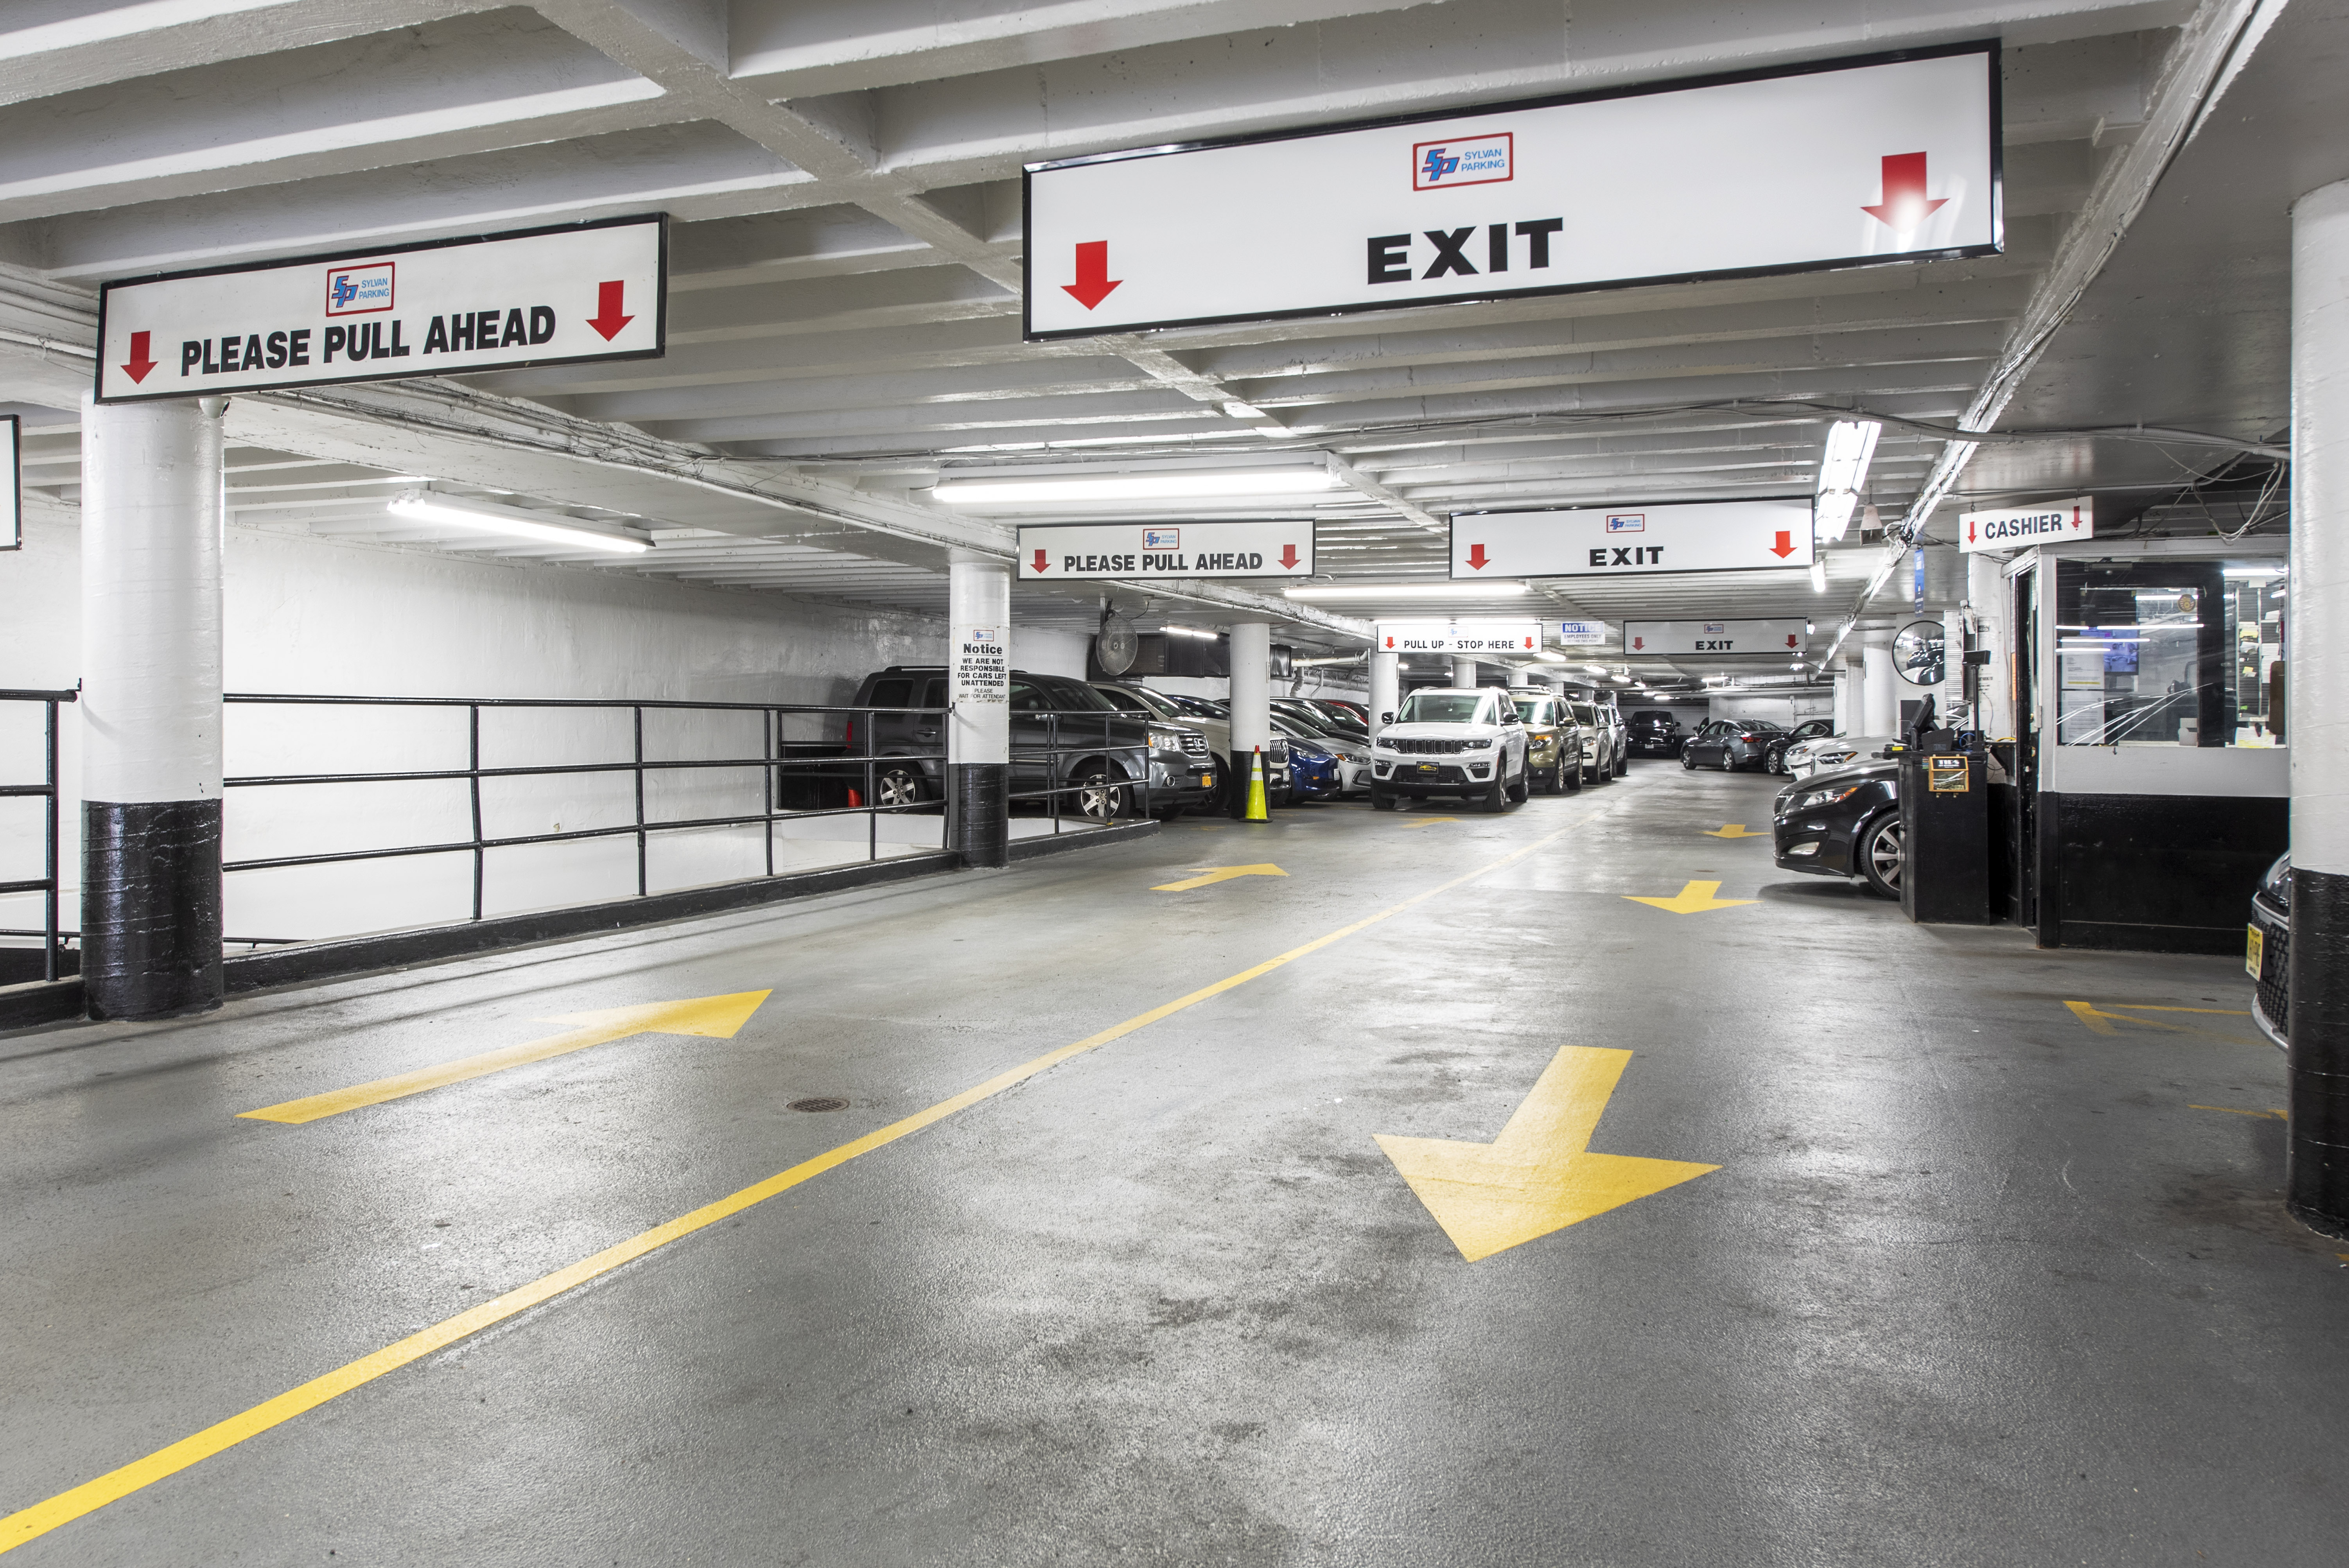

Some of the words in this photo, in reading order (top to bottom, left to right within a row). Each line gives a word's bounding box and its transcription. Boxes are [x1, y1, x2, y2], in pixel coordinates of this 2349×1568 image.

[1464, 148, 1502, 161] SYLVAN
[1461, 159, 1505, 172] PARKING
[1367, 217, 1563, 285] EXIT
[361, 277, 388, 288] SYLVAN
[359, 288, 389, 300] PARKING
[181, 329, 310, 377] PLEASE
[323, 320, 410, 363] PULL
[423, 306, 556, 354] AHEAD
[1985, 513, 2062, 539] CASHIER
[1064, 554, 1135, 572] PLEASE
[1142, 554, 1188, 571] PULL
[1195, 553, 1262, 570] AHEAD
[1590, 546, 1664, 567] EXIT
[964, 644, 1002, 654] Notice
[1404, 640, 1428, 649] PULL
[1432, 640, 1444, 649] UP
[1457, 640, 1483, 649] STOP
[1488, 640, 1515, 649] HERE
[1696, 640, 1733, 650] EXIT
